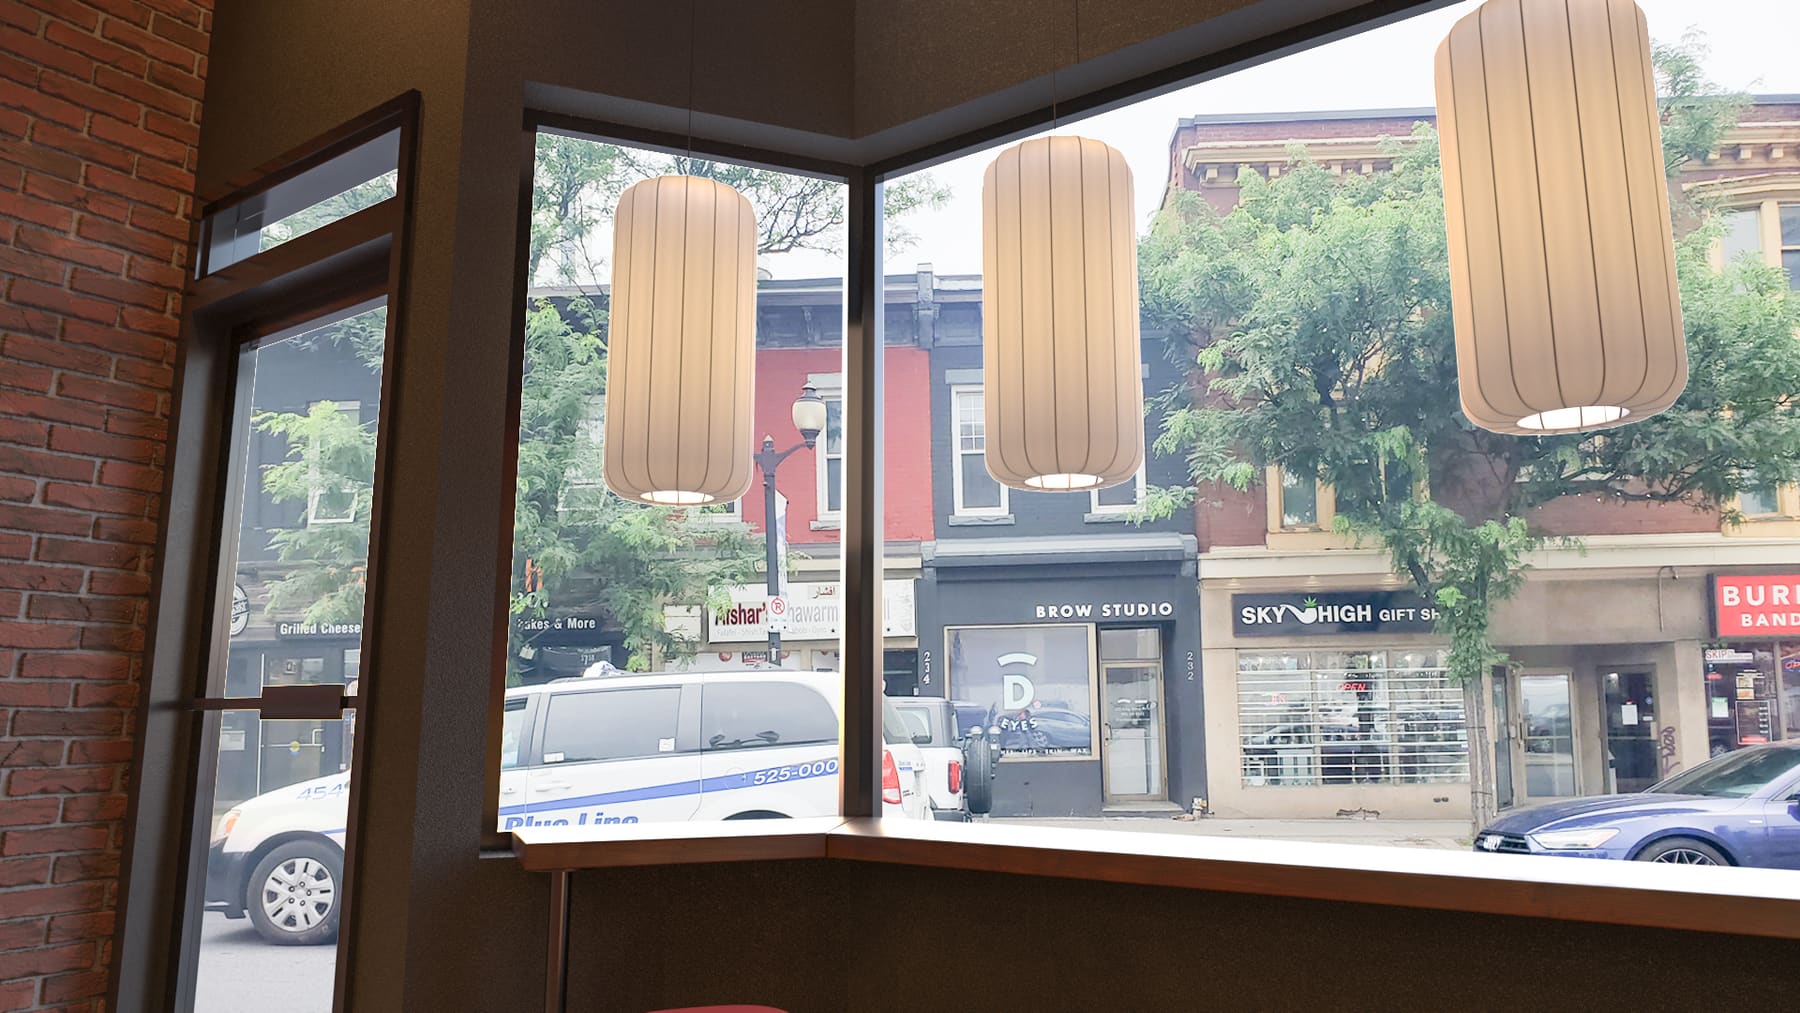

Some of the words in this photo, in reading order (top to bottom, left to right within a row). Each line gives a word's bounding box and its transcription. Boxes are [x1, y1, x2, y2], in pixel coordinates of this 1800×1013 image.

[1723, 584, 1800, 606] BUR
[1036, 604, 1093, 618] BROW
[1102, 602, 1173, 617] STUDIO
[1241, 606, 1286, 625] SKY
[1318, 604, 1372, 623] HIGH
[1379, 608, 1416, 622] GIFT
[280, 622, 317, 635] Grilled
[320, 622, 361, 634] Cheese
[567, 618, 597, 630] More
[922, 651, 931, 685] 234
[1186, 651, 1194, 681] 232
[1336, 682, 1367, 691] OPEN
[1001, 716, 1038, 732] EYES
